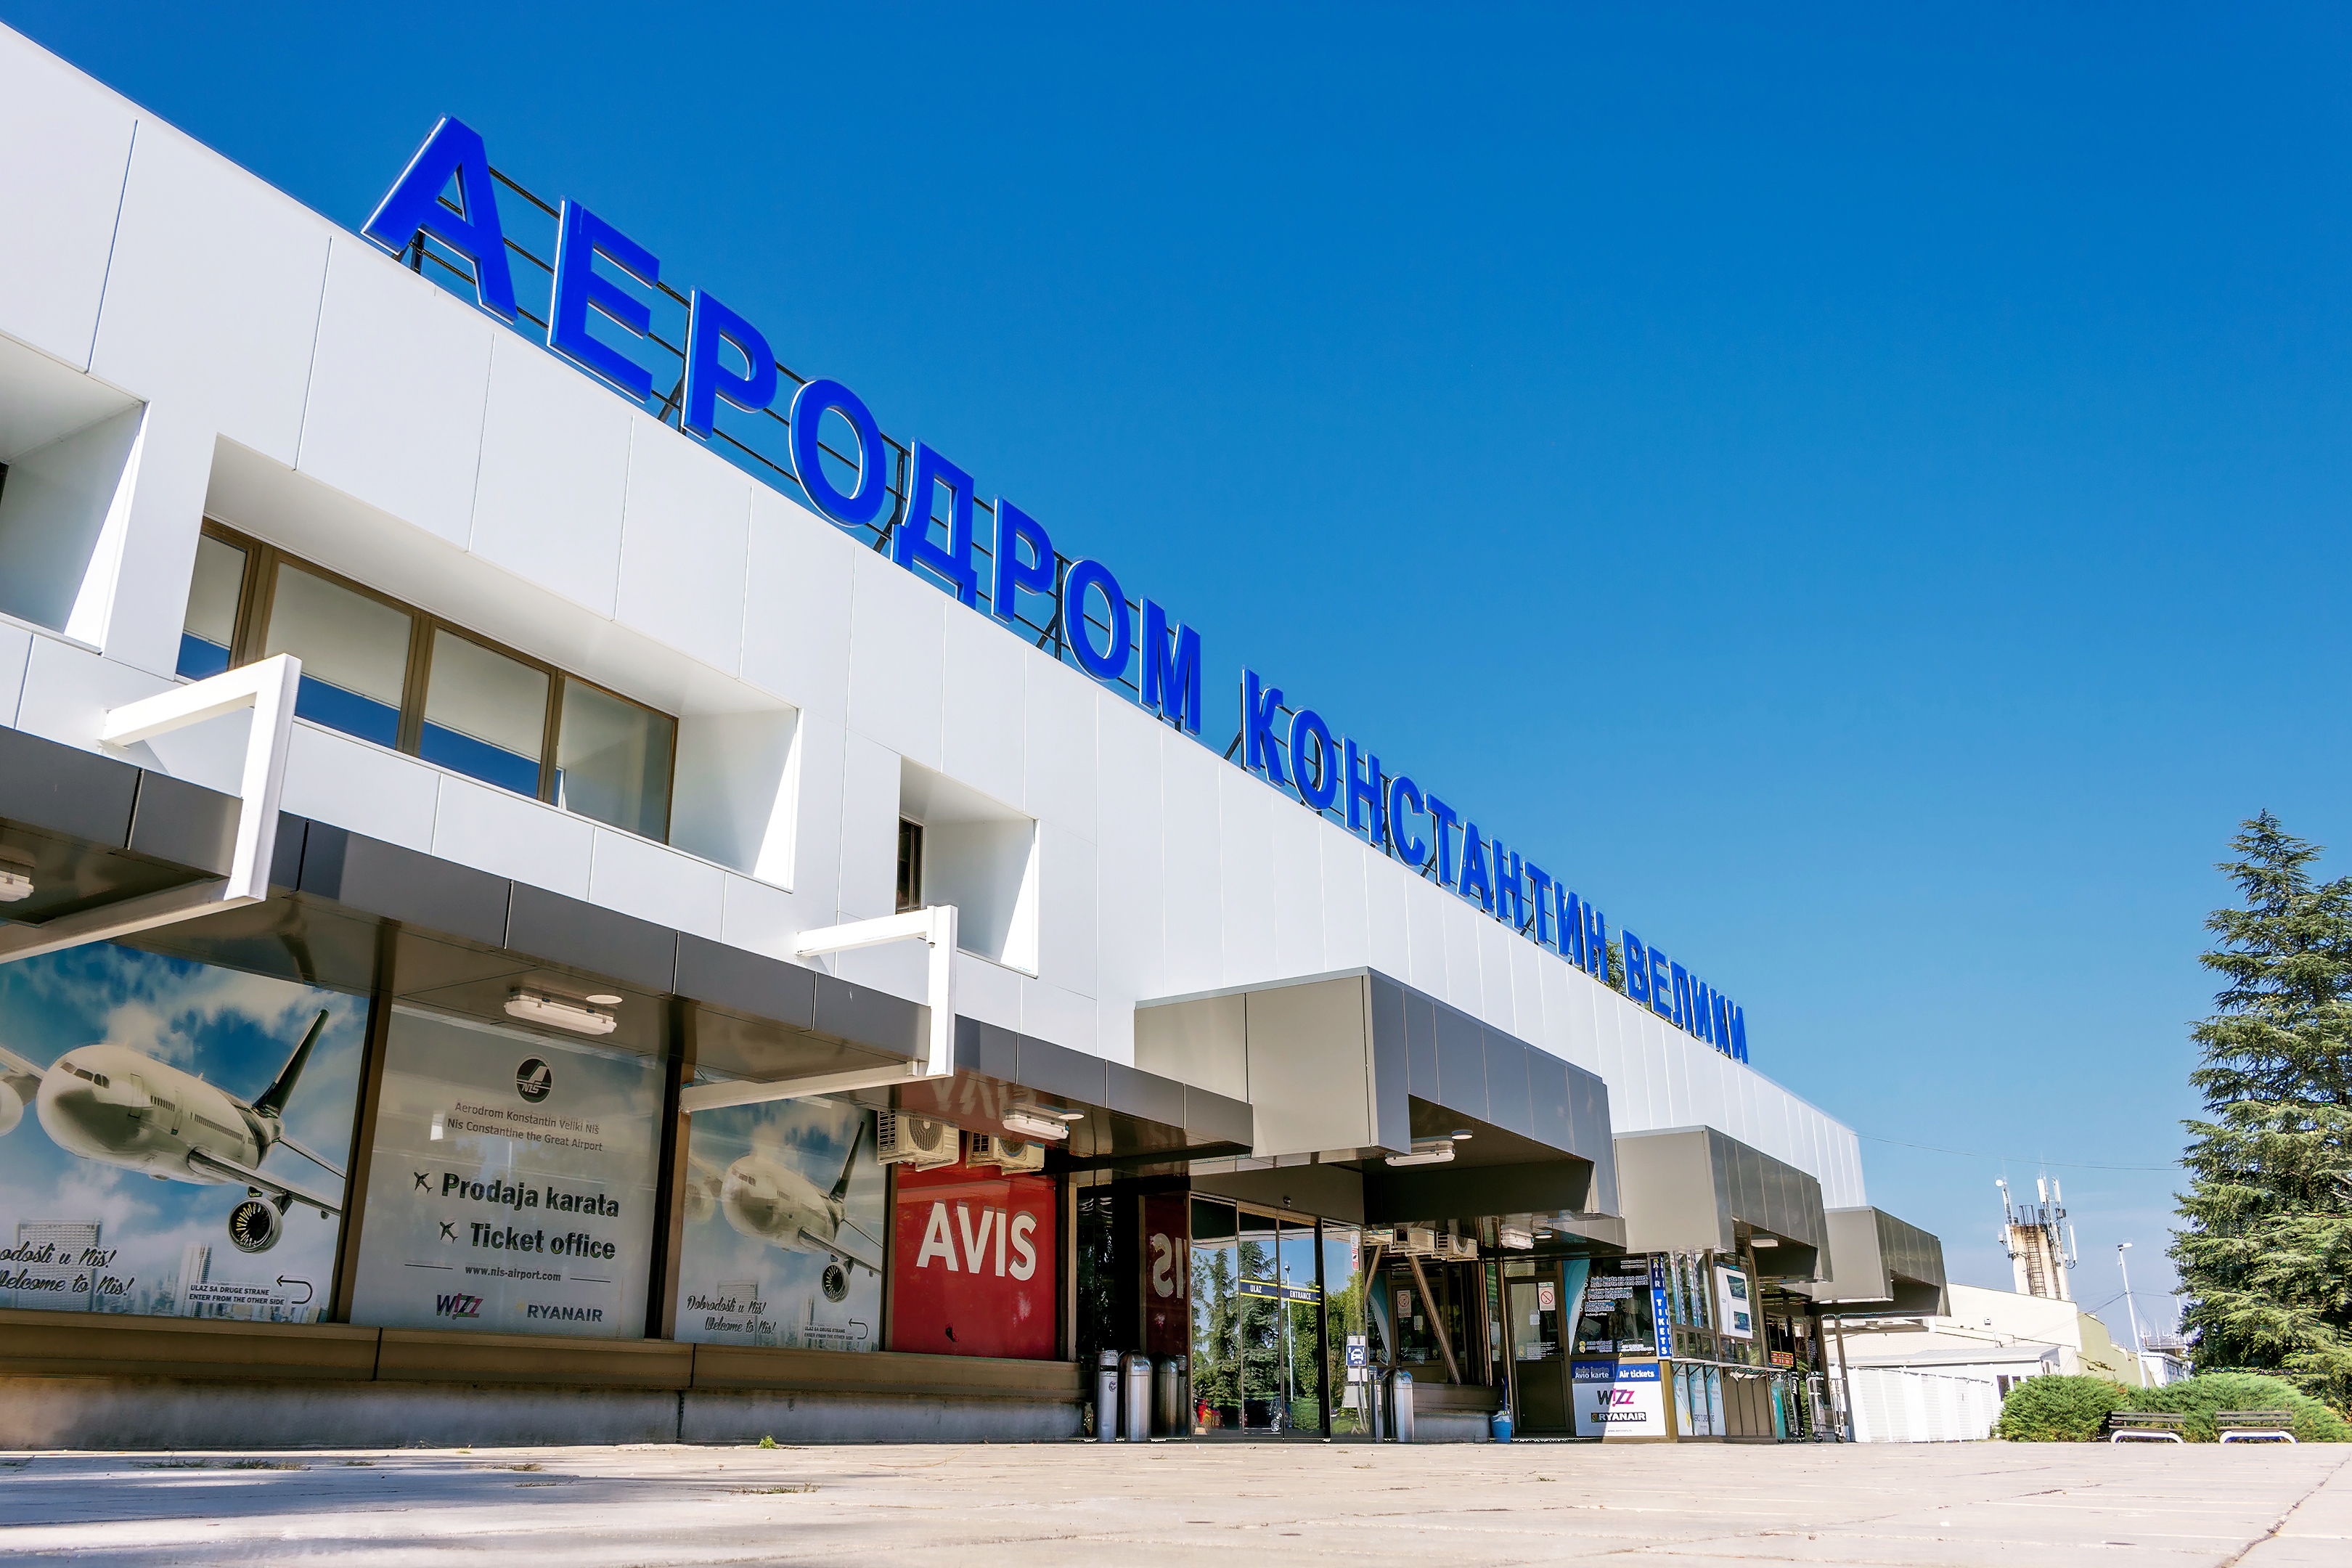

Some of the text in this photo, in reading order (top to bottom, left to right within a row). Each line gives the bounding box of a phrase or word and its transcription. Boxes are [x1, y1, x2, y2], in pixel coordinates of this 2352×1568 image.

[361, 114, 1749, 1066] АЕРОДРОМ КОНСТАНТИН ВЕЛИКИ
[454, 1102, 600, 1135] Aerodrom Konstantin Veliki Niš
[447, 1118, 603, 1152] Nis Constantine the Great Airport
[441, 1172, 619, 1217] Prodaja karata
[470, 1222, 616, 1259] Ticket office
[915, 1198, 1038, 1281] AVIS
[0, 1241, 118, 1269] odošli u Niš!
[465, 1265, 562, 1282] www.nis-airport.com
[73, 1273, 89, 1293] to
[97, 1275, 135, 1297] Nis!
[190, 1284, 208, 1293] ULAZ
[220, 1286, 243, 1295] DRUGE
[245, 1288, 270, 1297] STRANE
[1249, 1284, 1312, 1300] ULAZ ENTRANCE
[247, 1297, 269, 1305] OTHER
[687, 1294, 737, 1312] Dobrodošli
[739, 1304, 745, 1313] u
[526, 1303, 603, 1323] RYANAIR
[705, 1316, 743, 1333] Welcome
[746, 1320, 754, 1334] to
[1619, 1369, 1655, 1379] Air tickets
[1598, 1413, 1646, 1421] RYANAIR
